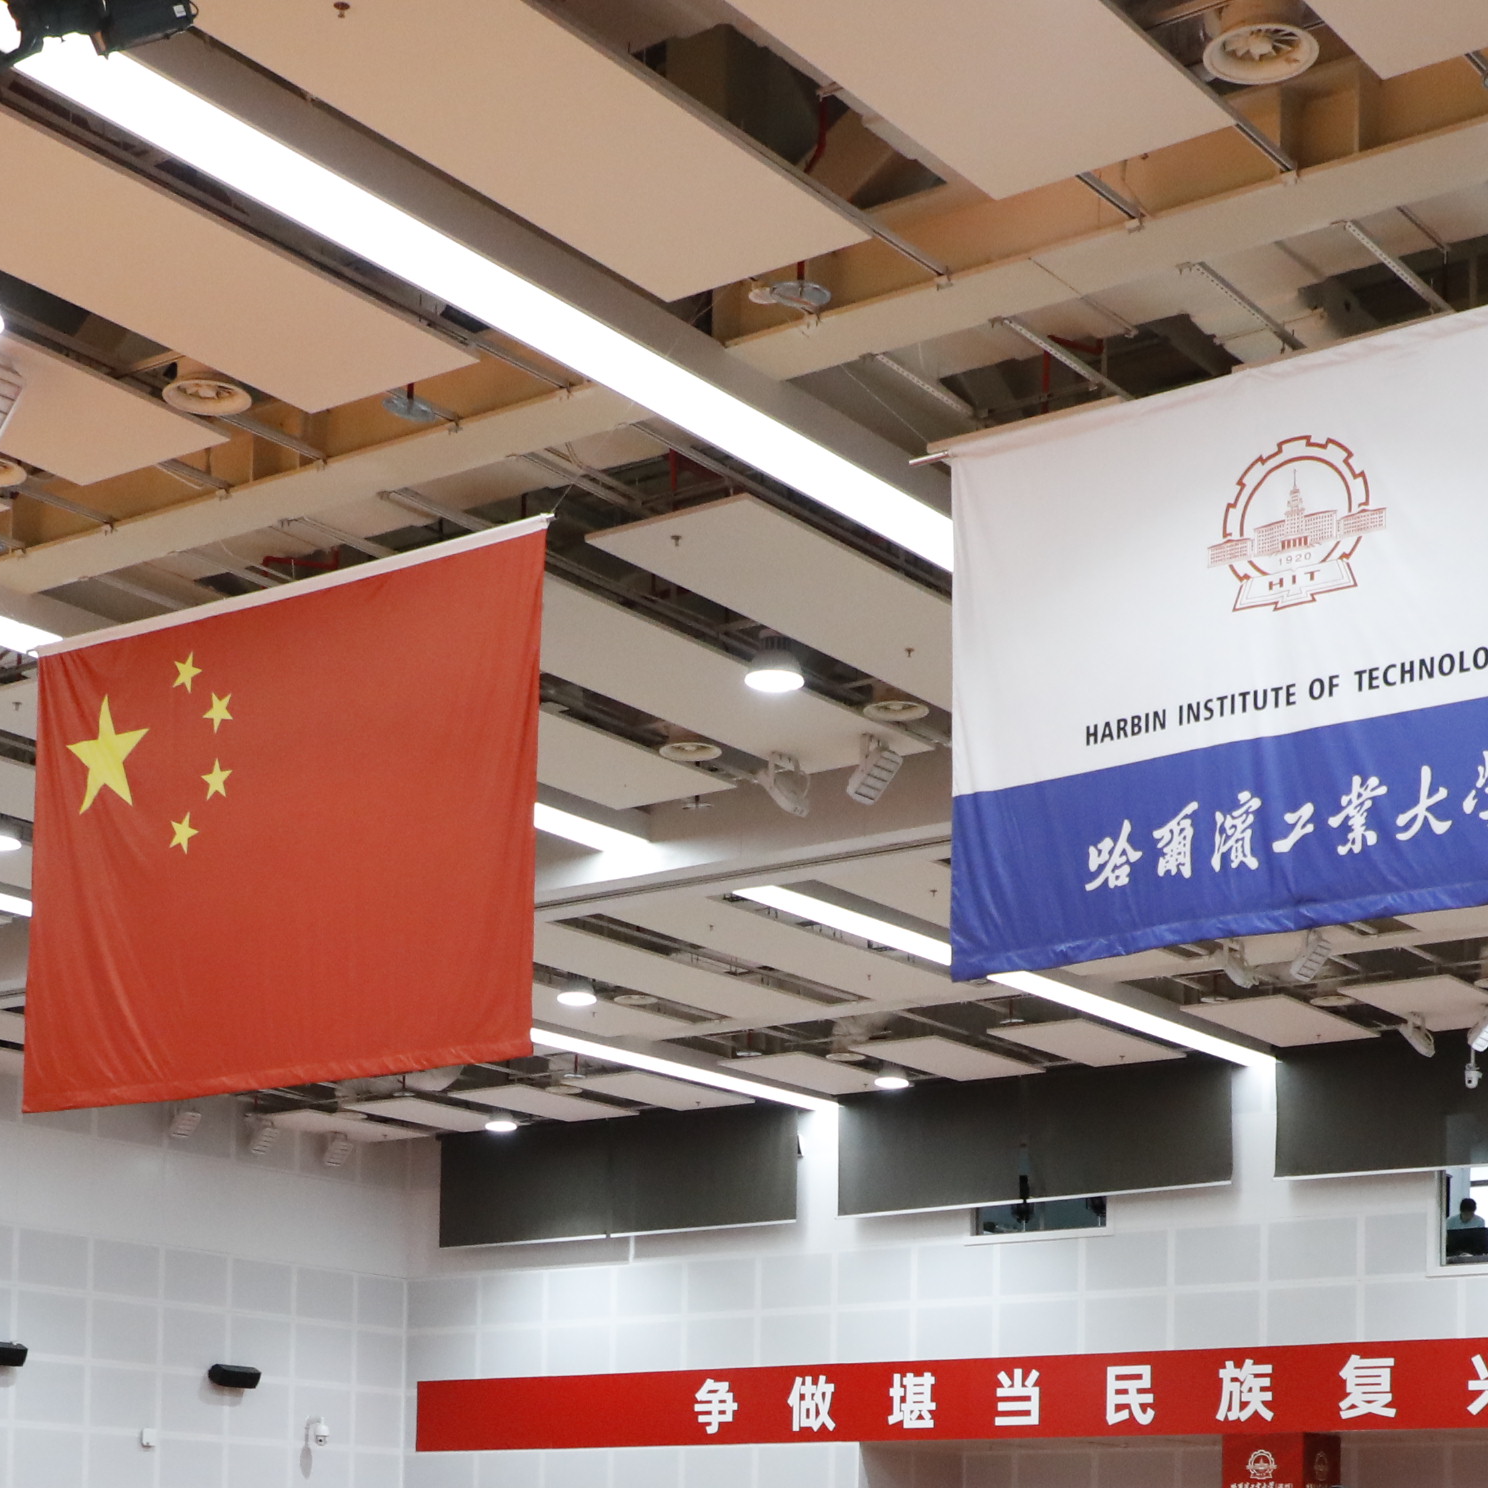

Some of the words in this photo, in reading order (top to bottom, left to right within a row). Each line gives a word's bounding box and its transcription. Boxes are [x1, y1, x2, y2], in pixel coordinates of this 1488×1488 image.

[1278, 551, 1312, 566] 1920
[1268, 569, 1321, 591] HIT
[1085, 704, 1167, 747] HARBIN
[1178, 682, 1298, 727] INSTITUTE
[1308, 674, 1340, 701] OF
